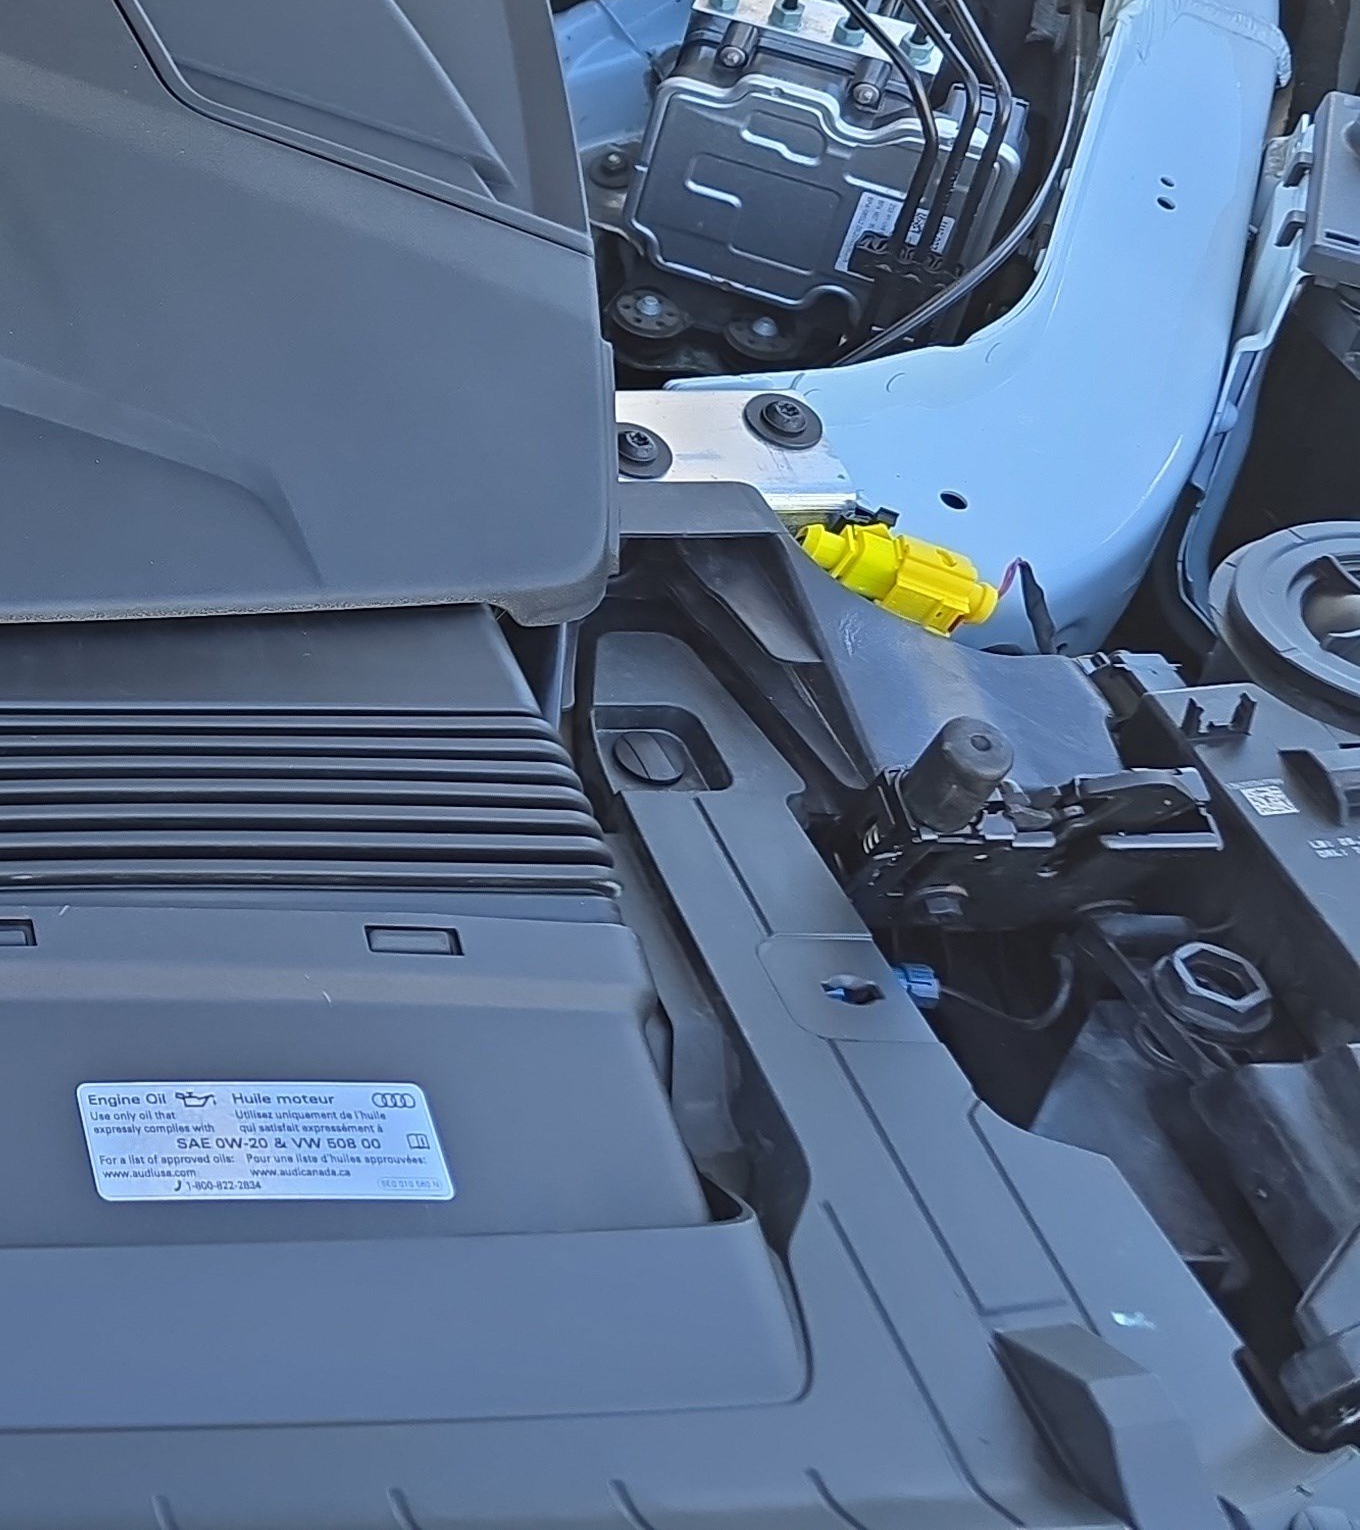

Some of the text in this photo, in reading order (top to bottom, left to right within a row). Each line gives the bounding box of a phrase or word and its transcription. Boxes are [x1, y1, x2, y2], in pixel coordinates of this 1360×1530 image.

[88, 1093, 167, 1107] Engine Oil
[232, 1093, 335, 1105] Huile moteur
[90, 1110, 176, 1123] Use only oil that
[235, 1110, 273, 1120] Utilisez
[274, 1110, 338, 1122] uniquement
[339, 1110, 353, 1120] de
[93, 1123, 216, 1135] expressly complies with
[239, 1122, 385, 1135] qui satisfait expressément à
[176, 1137, 382, 1150] SAE 0W-20 & VW 508 00
[99, 1153, 236, 1167] For a list of approved oils:
[246, 1154, 272, 1165] Pour
[273, 1155, 294, 1164] une
[296, 1153, 319, 1164] liste
[101, 1168, 197, 1179] www.audiusa.com
[249, 1167, 351, 1178] www.audicanada.ca
[186, 1181, 262, 1191] 1-800-822-2834
